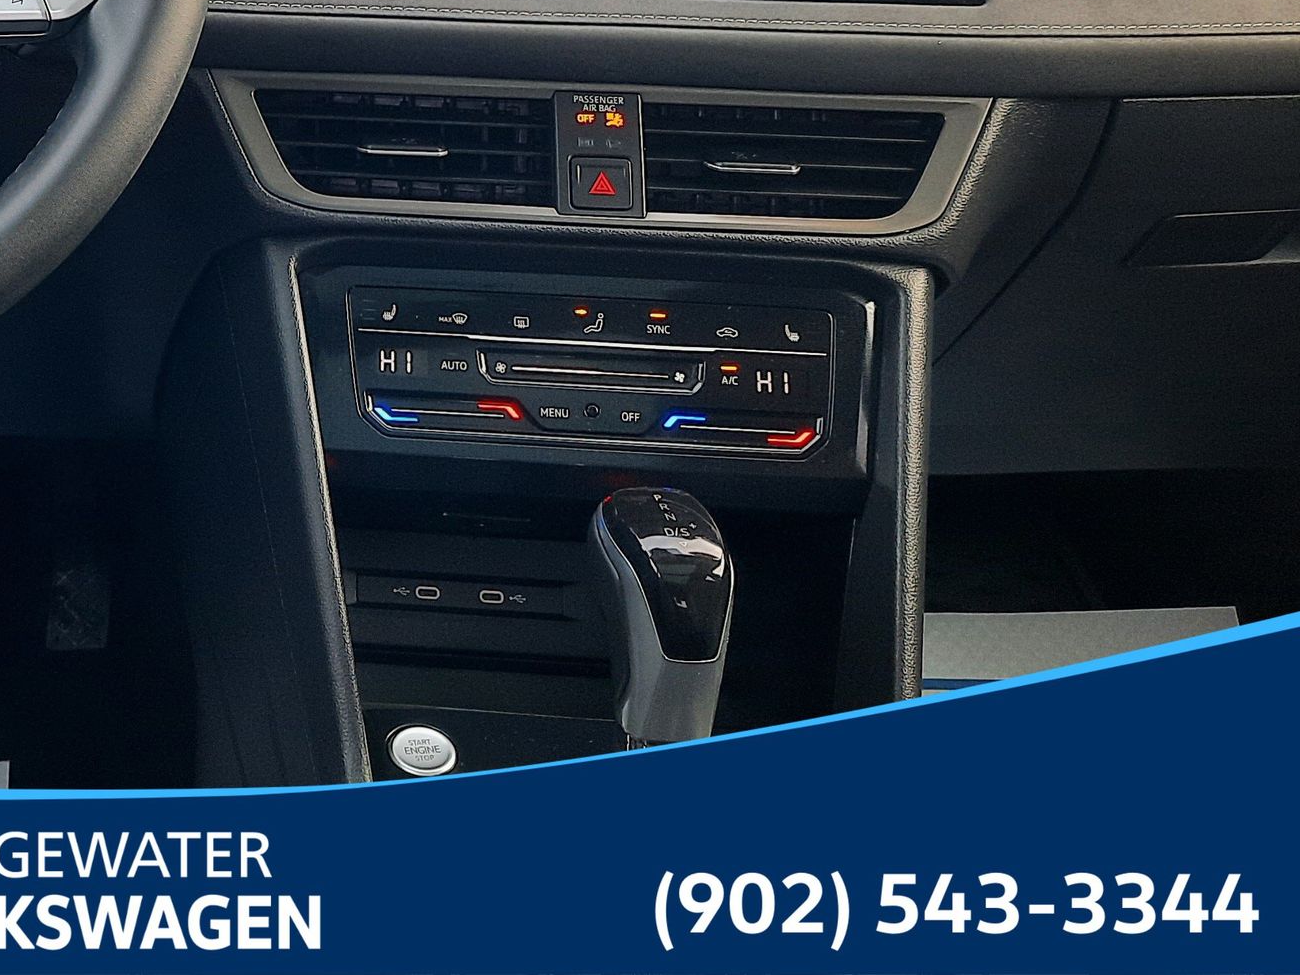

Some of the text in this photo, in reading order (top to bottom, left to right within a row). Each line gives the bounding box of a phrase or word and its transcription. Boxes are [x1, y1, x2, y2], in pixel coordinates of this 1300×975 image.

[573, 95, 625, 105] PASSENGER
[583, 104, 617, 113] AIR BAG
[577, 114, 595, 123] OFF
[647, 325, 671, 335] SYNC
[441, 360, 468, 371] AUTO
[721, 376, 739, 386] A/C
[540, 407, 569, 418] MENU
[621, 412, 640, 422] OFF
[659, 503, 670, 511] R
[664, 513, 677, 521] N
[408, 738, 432, 746] START
[404, 745, 441, 755] ENGINE
[415, 754, 435, 762] STOP
